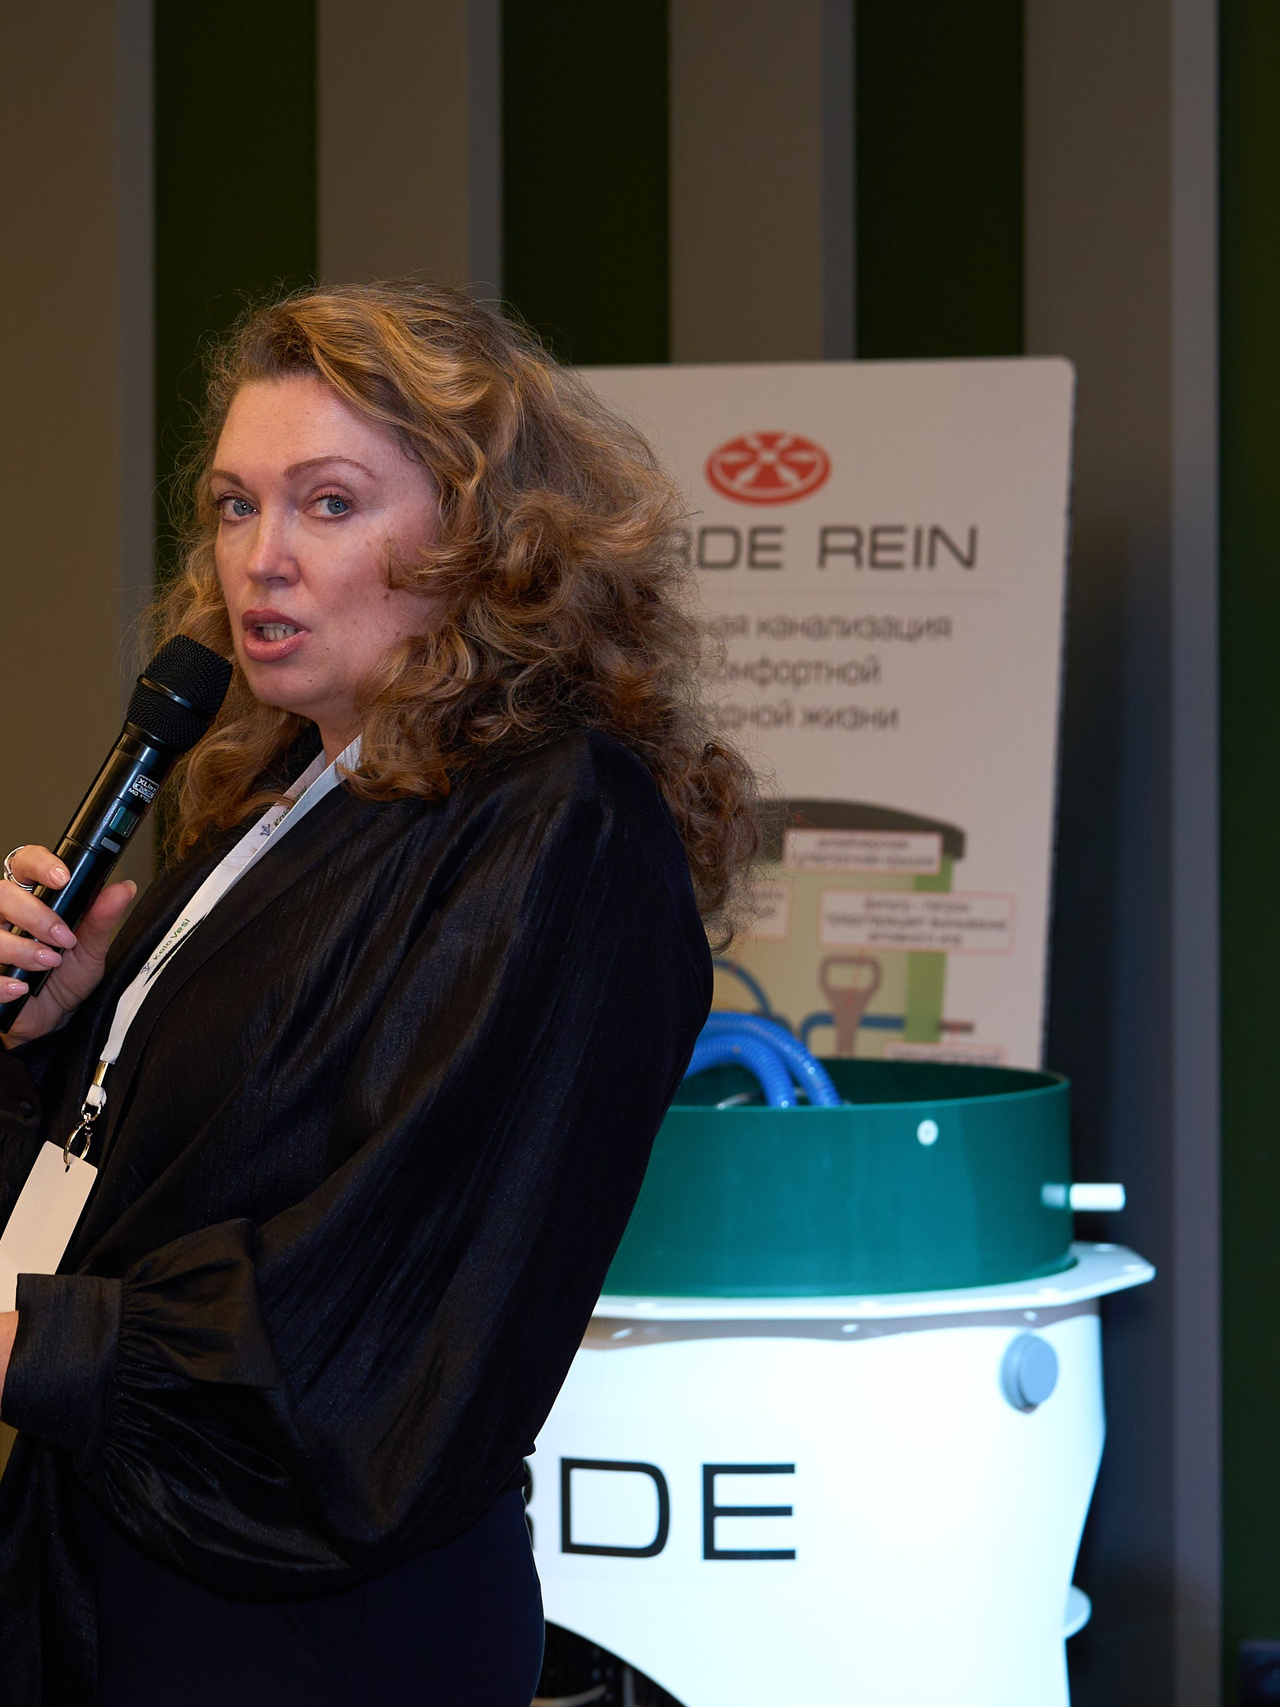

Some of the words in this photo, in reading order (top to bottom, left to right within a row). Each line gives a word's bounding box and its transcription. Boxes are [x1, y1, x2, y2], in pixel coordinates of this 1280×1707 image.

[817, 524, 978, 570] REIN
[756, 613, 953, 643] канализация
[801, 704, 900, 731] жизни
[523, 1457, 797, 1560] DE
